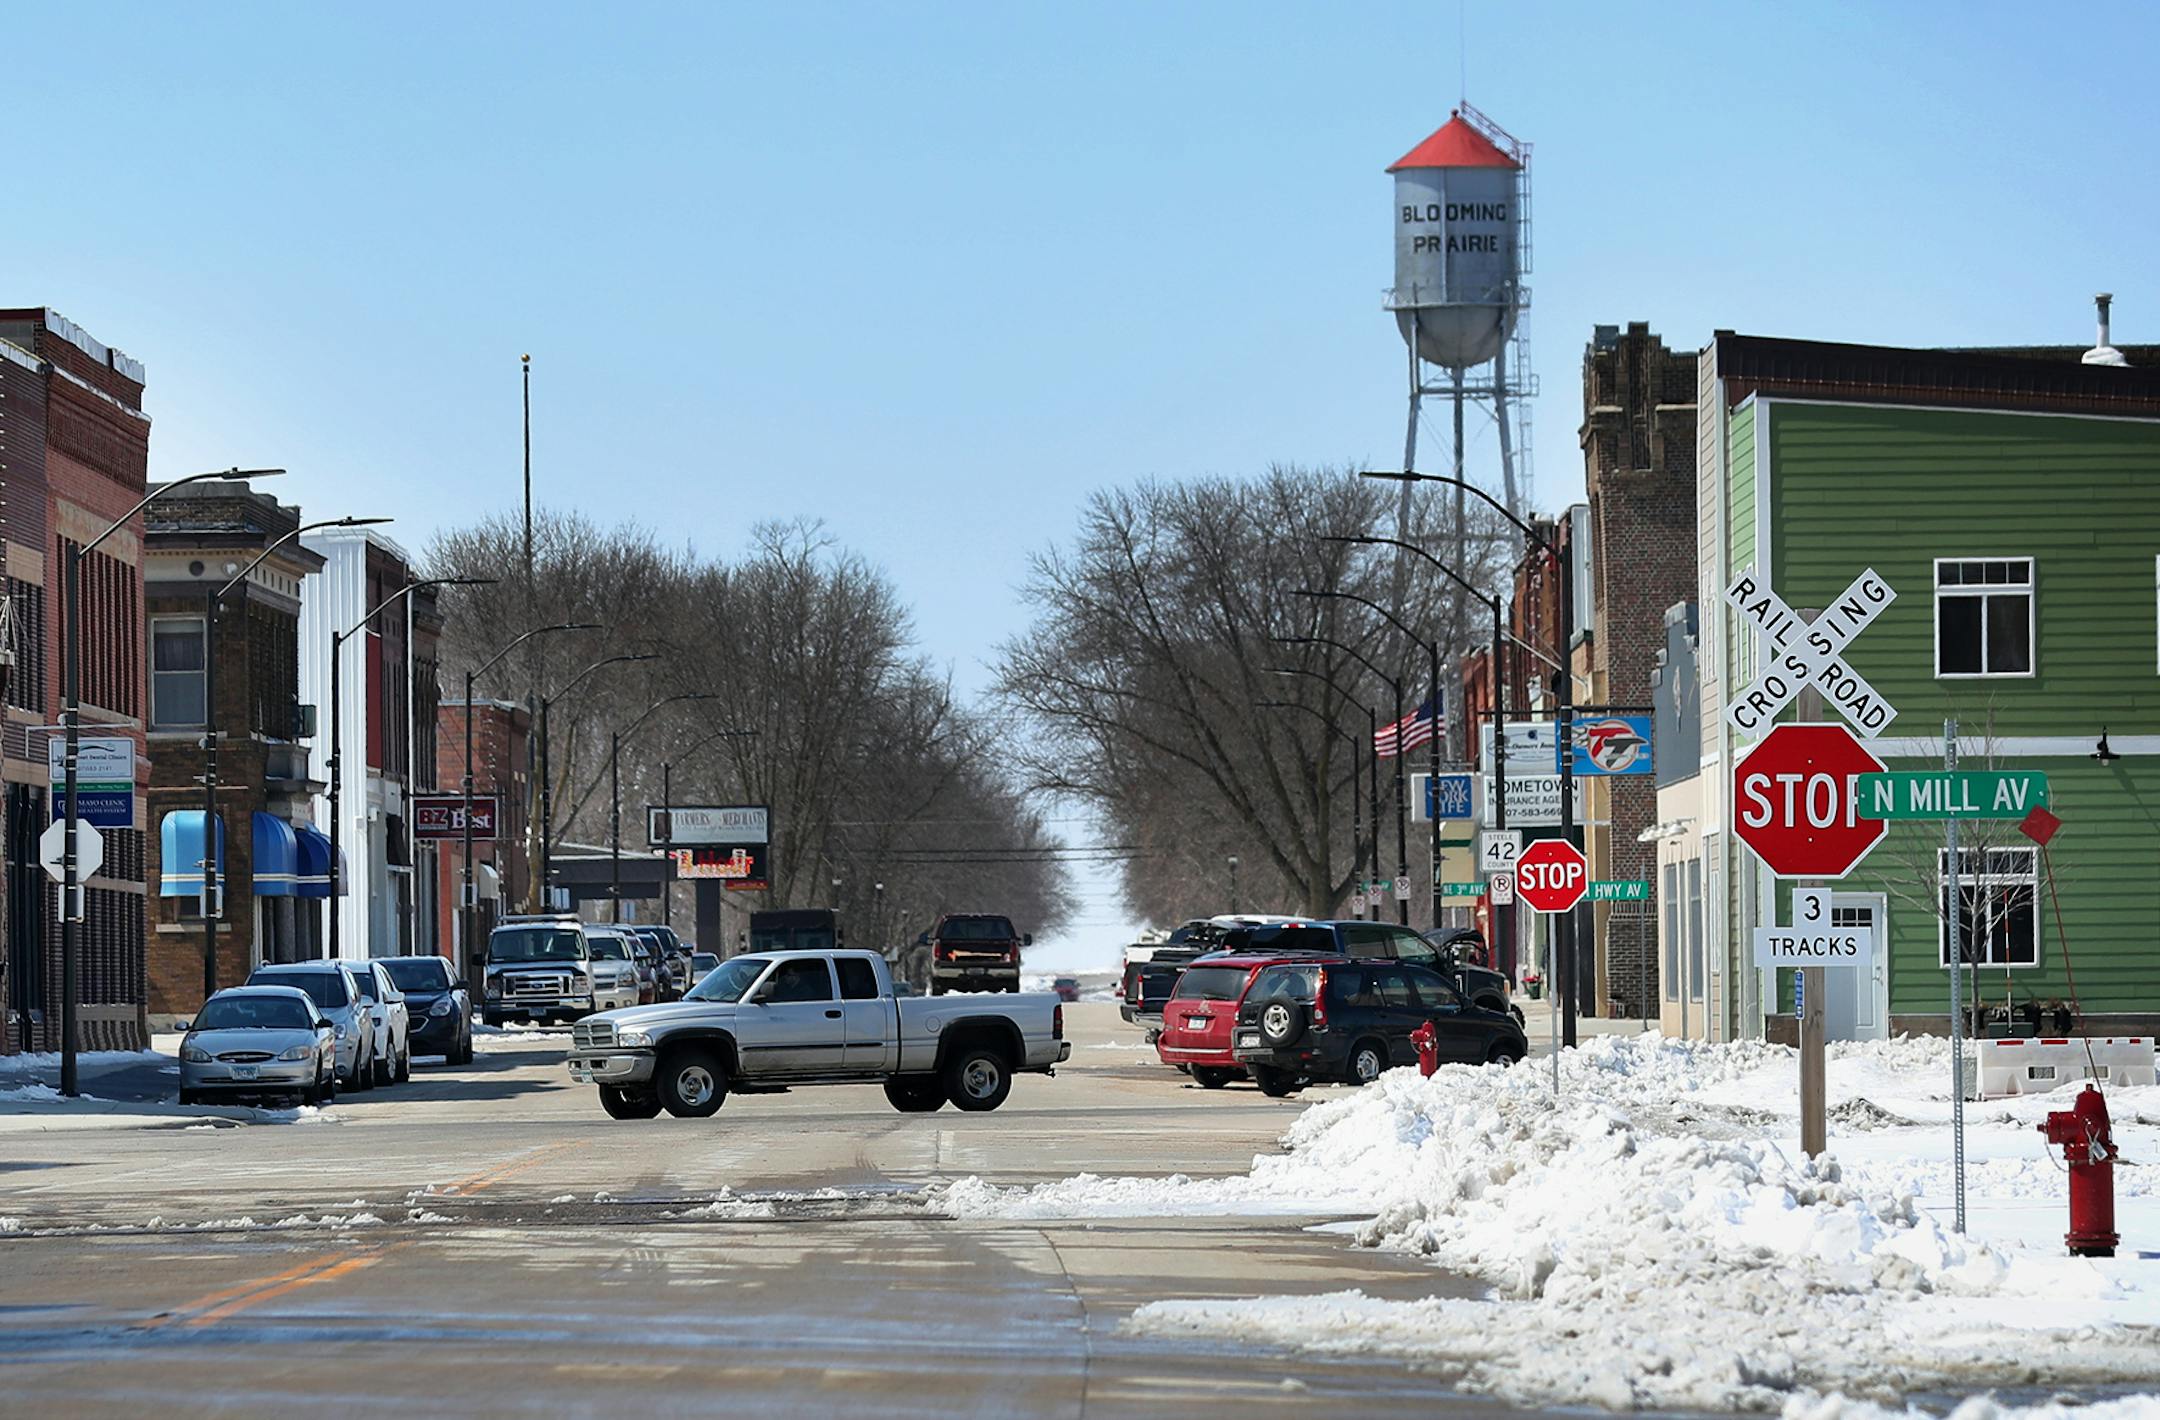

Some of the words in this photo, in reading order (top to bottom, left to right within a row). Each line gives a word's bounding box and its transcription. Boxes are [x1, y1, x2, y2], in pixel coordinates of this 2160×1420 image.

[1402, 203, 1506, 223] BLOOMING
[1413, 235, 1498, 253] PRAIRIE
[1734, 580, 1885, 729] CROSSING
[1440, 779, 1465, 792] EW
[1428, 790, 1469, 802] ORK
[1488, 795, 1540, 806] INURANCE
[1542, 795, 1579, 804] AGEY
[1874, 780, 1894, 812] N
[1910, 778, 1980, 811] MILL
[1993, 778, 2030, 811] AV
[1440, 801, 1465, 814] IFE
[451, 807, 493, 829] Bst
[1487, 842, 1515, 860] 42
[1520, 862, 1583, 890] STOP
[1595, 884, 1622, 898] HWY
[1626, 884, 1642, 897] AV
[1804, 896, 1821, 922] 3
[1769, 937, 1857, 956] TRACKS
